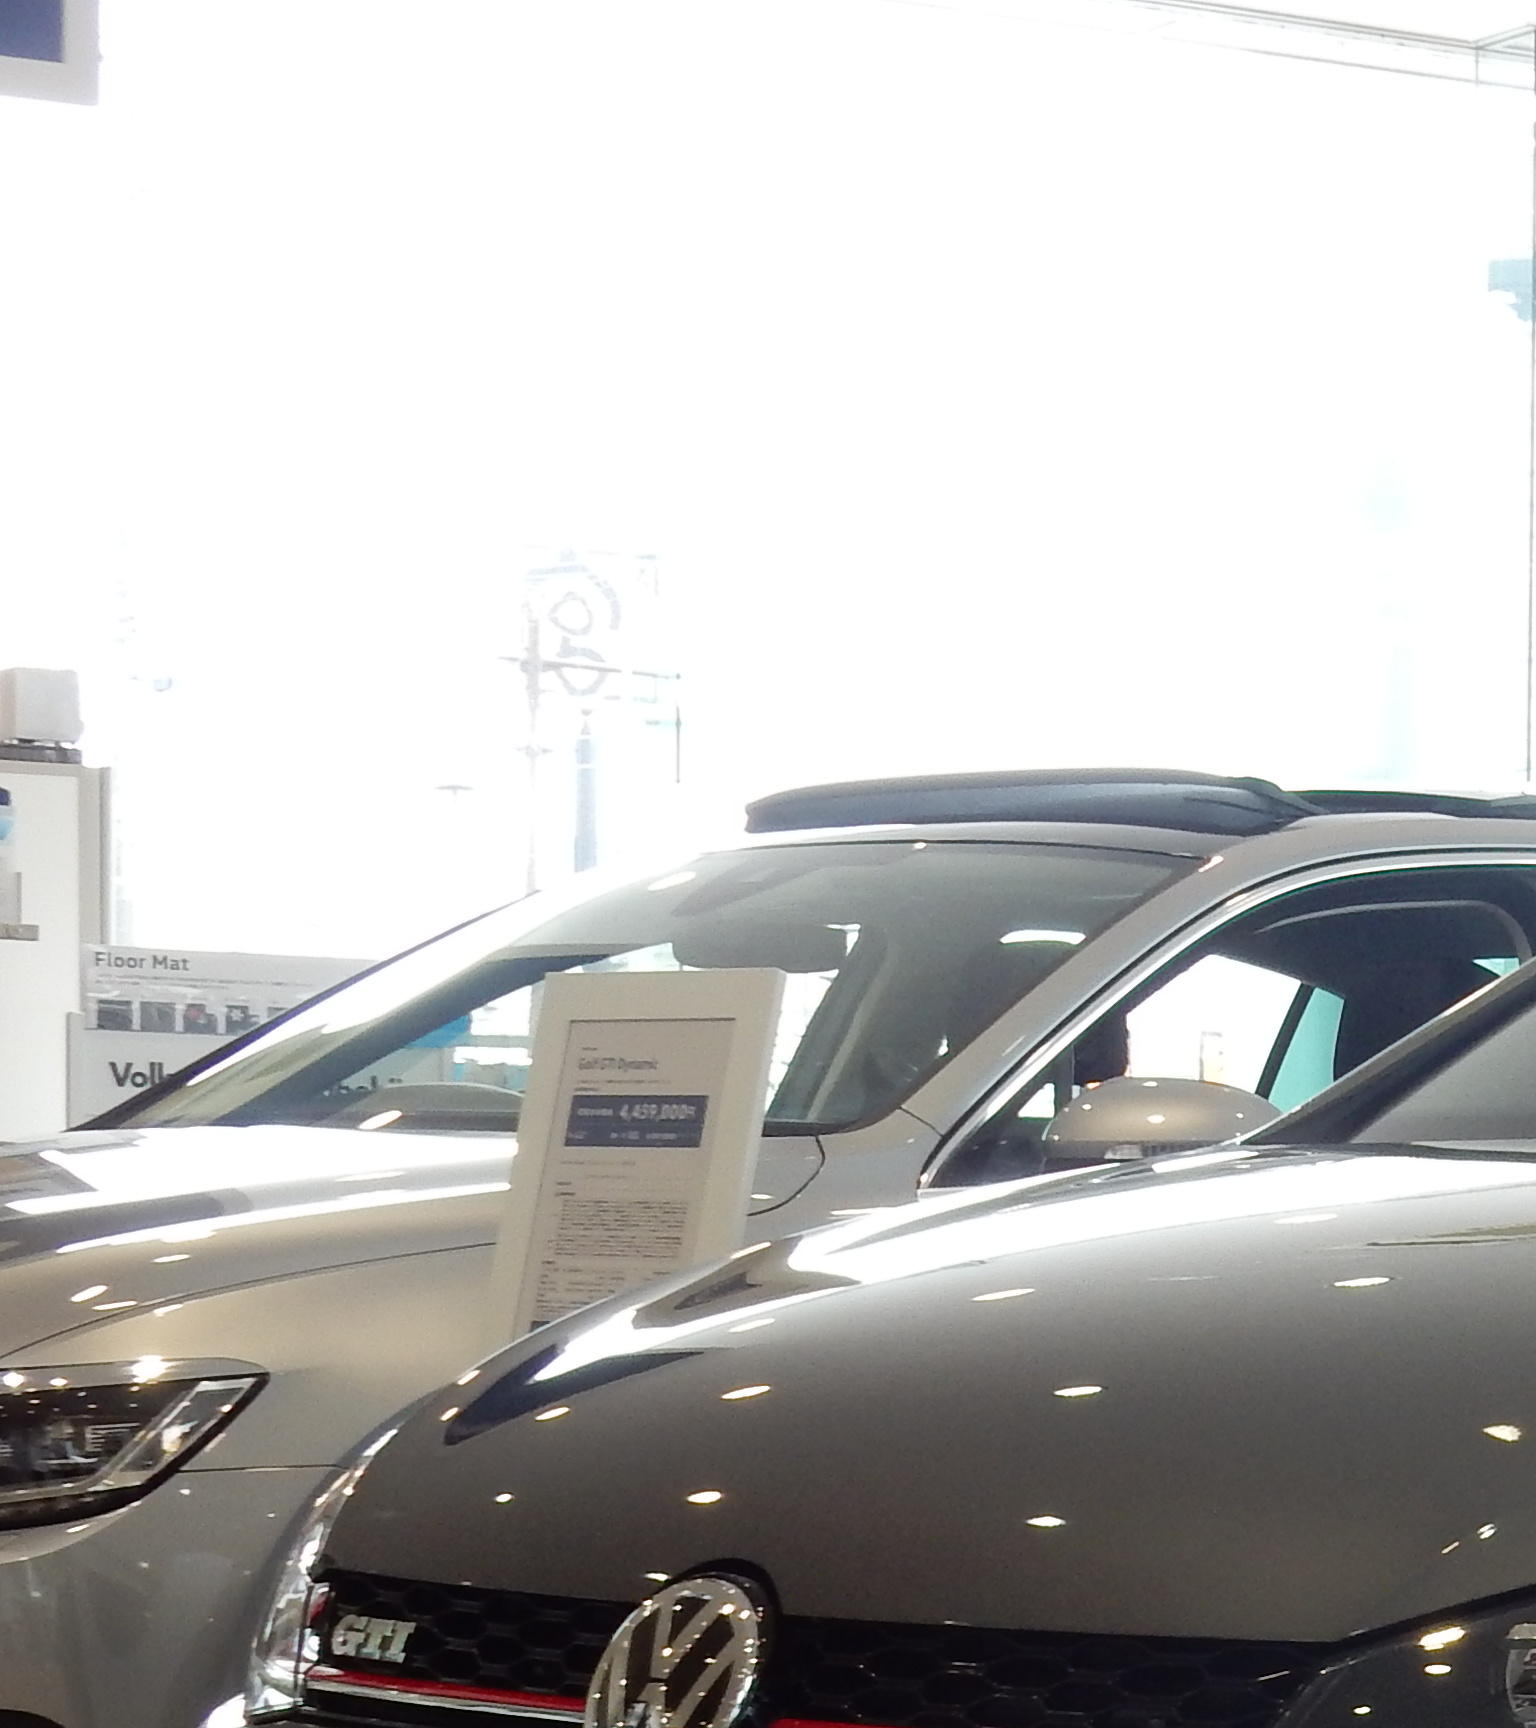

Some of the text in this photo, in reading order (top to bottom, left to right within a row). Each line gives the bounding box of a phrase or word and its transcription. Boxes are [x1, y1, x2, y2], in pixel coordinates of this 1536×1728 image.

[95, 951, 190, 971] Floor Mat
[331, 1614, 416, 1664] GTI
